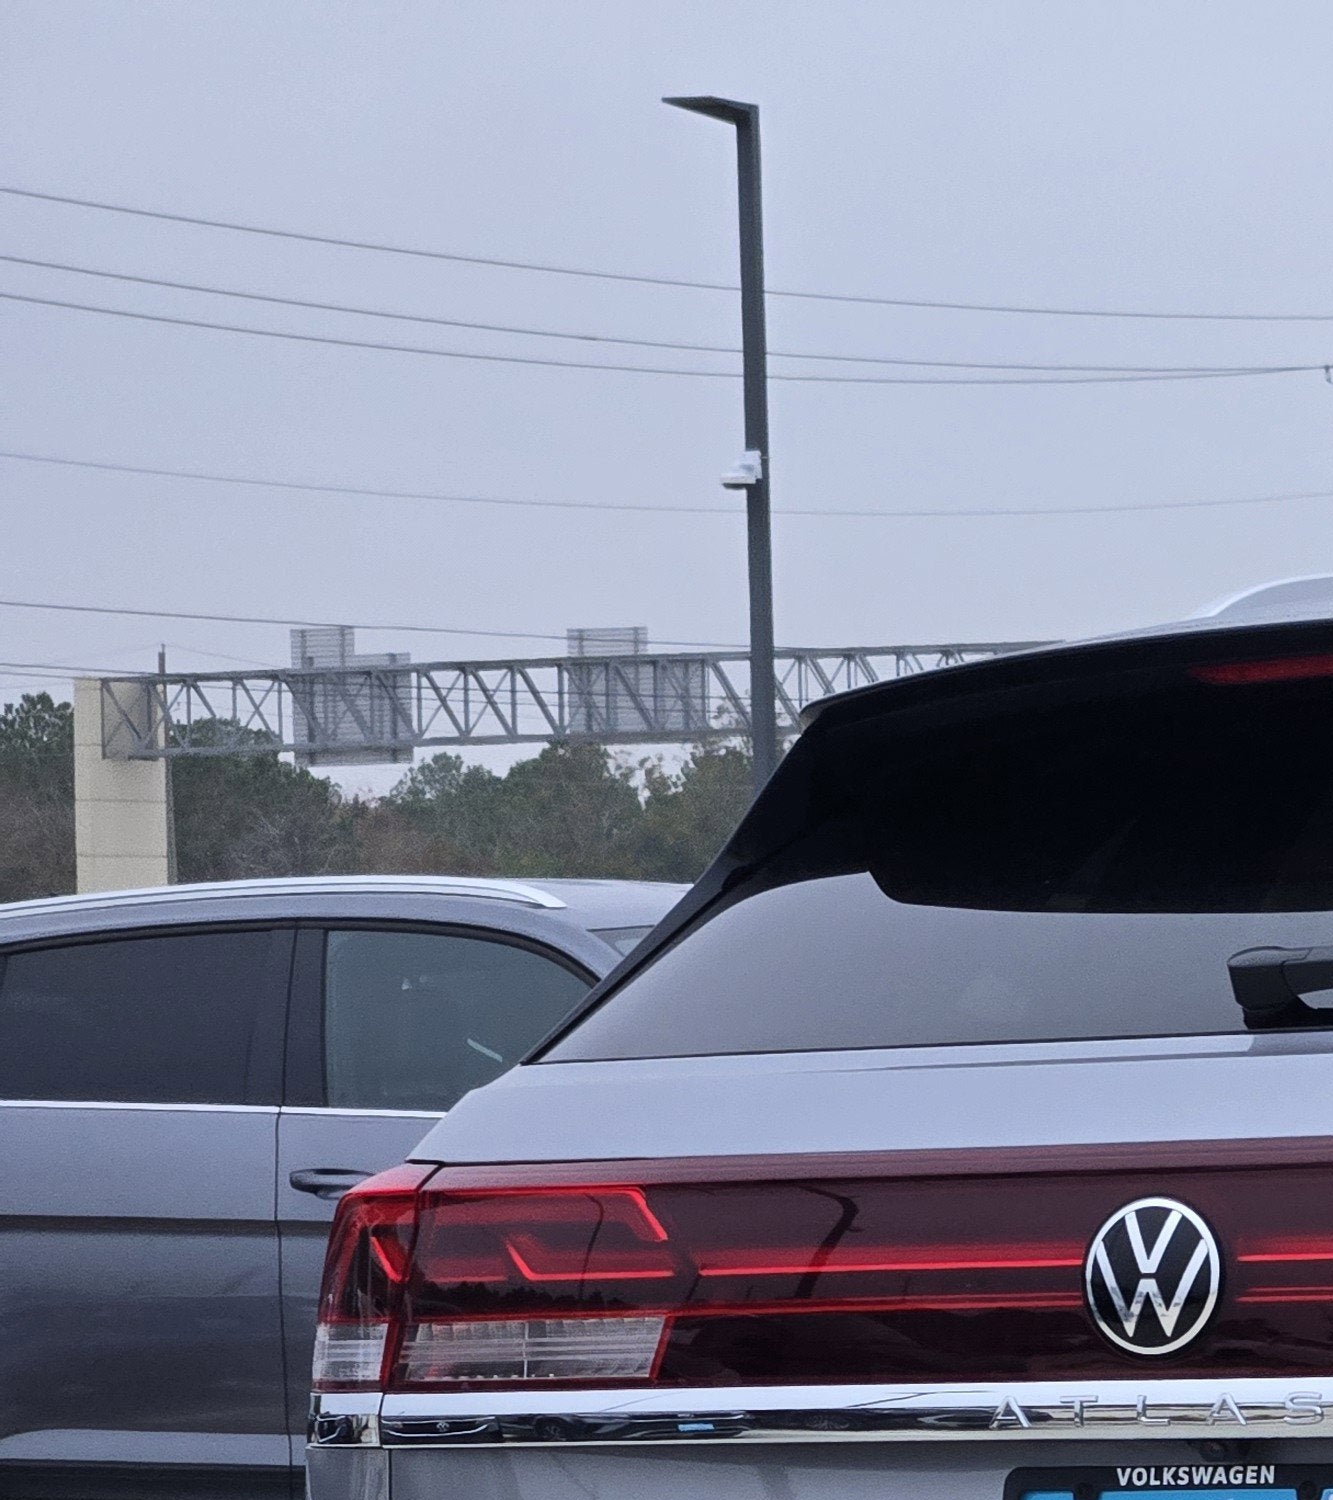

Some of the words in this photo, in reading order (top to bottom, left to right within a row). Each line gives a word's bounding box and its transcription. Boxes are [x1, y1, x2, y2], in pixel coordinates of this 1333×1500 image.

[1094, 1208, 1210, 1340] VW
[989, 1390, 1325, 1430] ATLAS
[1116, 1465, 1275, 1486] VOLKSWAGEN
